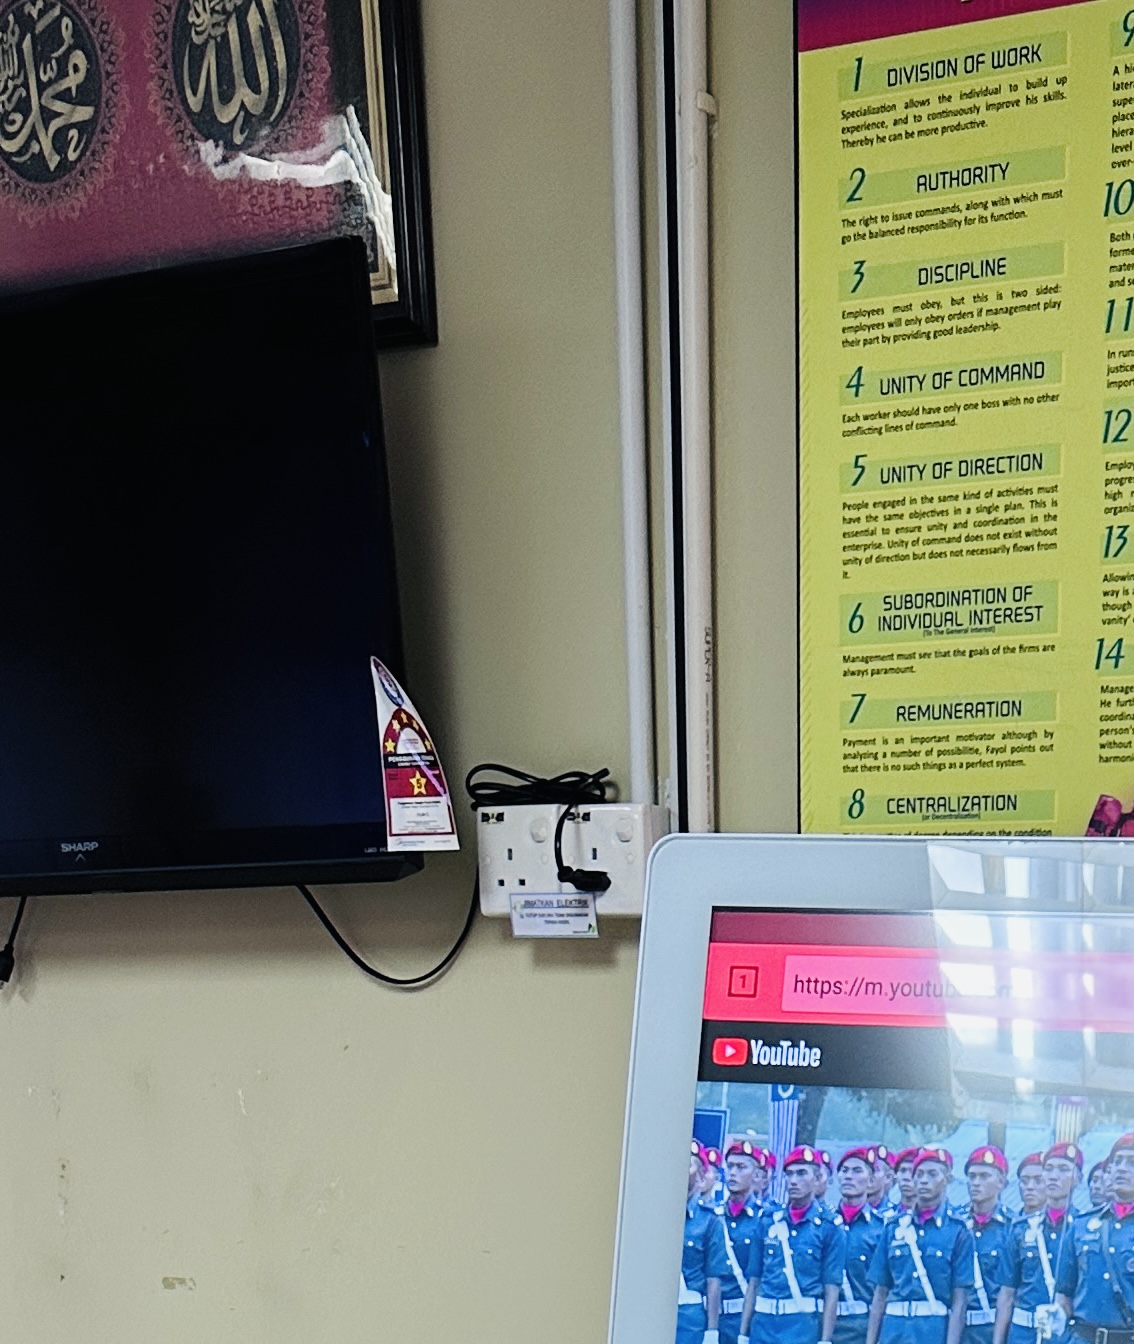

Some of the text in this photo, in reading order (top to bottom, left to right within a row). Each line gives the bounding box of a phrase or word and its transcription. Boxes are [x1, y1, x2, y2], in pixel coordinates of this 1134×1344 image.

[854, 43, 1042, 92] 1 DIVISION OF WORK
[1113, 66, 1119, 76] A
[846, 162, 1009, 202] 2 AUTHORITY
[850, 258, 1007, 293] 3 DISCIPLINE
[1105, 297, 1134, 333] 11
[846, 361, 1045, 397] 4 UNITY OF COMMAND
[1102, 408, 1132, 444] 12
[852, 453, 1043, 486] 5 UNITY OF DIRECTION
[1104, 525, 1130, 558] 13
[883, 586, 1033, 611] SUBORDINATION OF
[848, 602, 1044, 634] 6 INDIVIDUAL INTEREST
[1095, 638, 1125, 670] 14
[849, 693, 1022, 723] 7 REMUNERATION
[848, 788, 1017, 819] 8 CENTRALIZATION
[61, 842, 98, 852] SHARP
[739, 975, 747, 989] 1
[750, 1039, 821, 1068] YouTube
